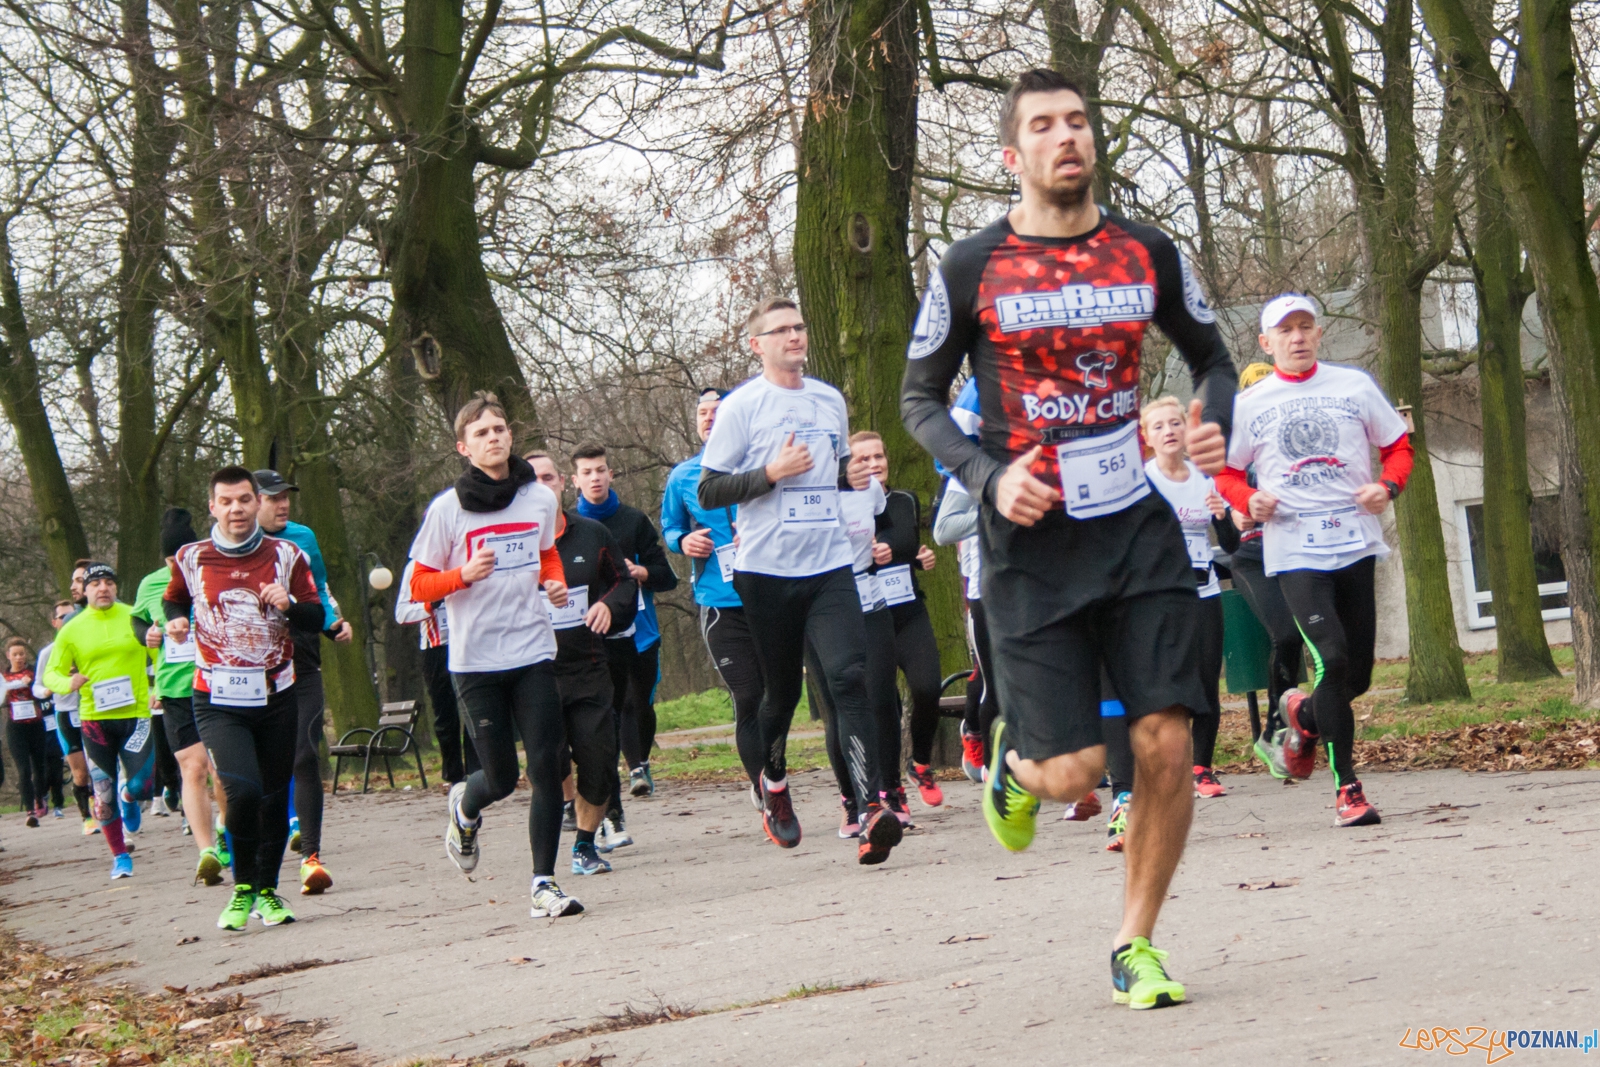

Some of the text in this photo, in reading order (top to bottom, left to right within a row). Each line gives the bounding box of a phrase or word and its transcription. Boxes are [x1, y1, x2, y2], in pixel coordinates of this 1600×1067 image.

[934, 284, 948, 322] COAST
[1018, 309, 1073, 323] WEST
[1078, 304, 1145, 318] COAST
[1021, 393, 1090, 424] BODY
[1098, 452, 1126, 475] 563
[803, 494, 822, 505] 180
[1320, 517, 1341, 530] 356
[505, 541, 524, 554] 274
[885, 576, 901, 587] 655
[229, 676, 248, 686] 824
[106, 685, 120, 695] 279
